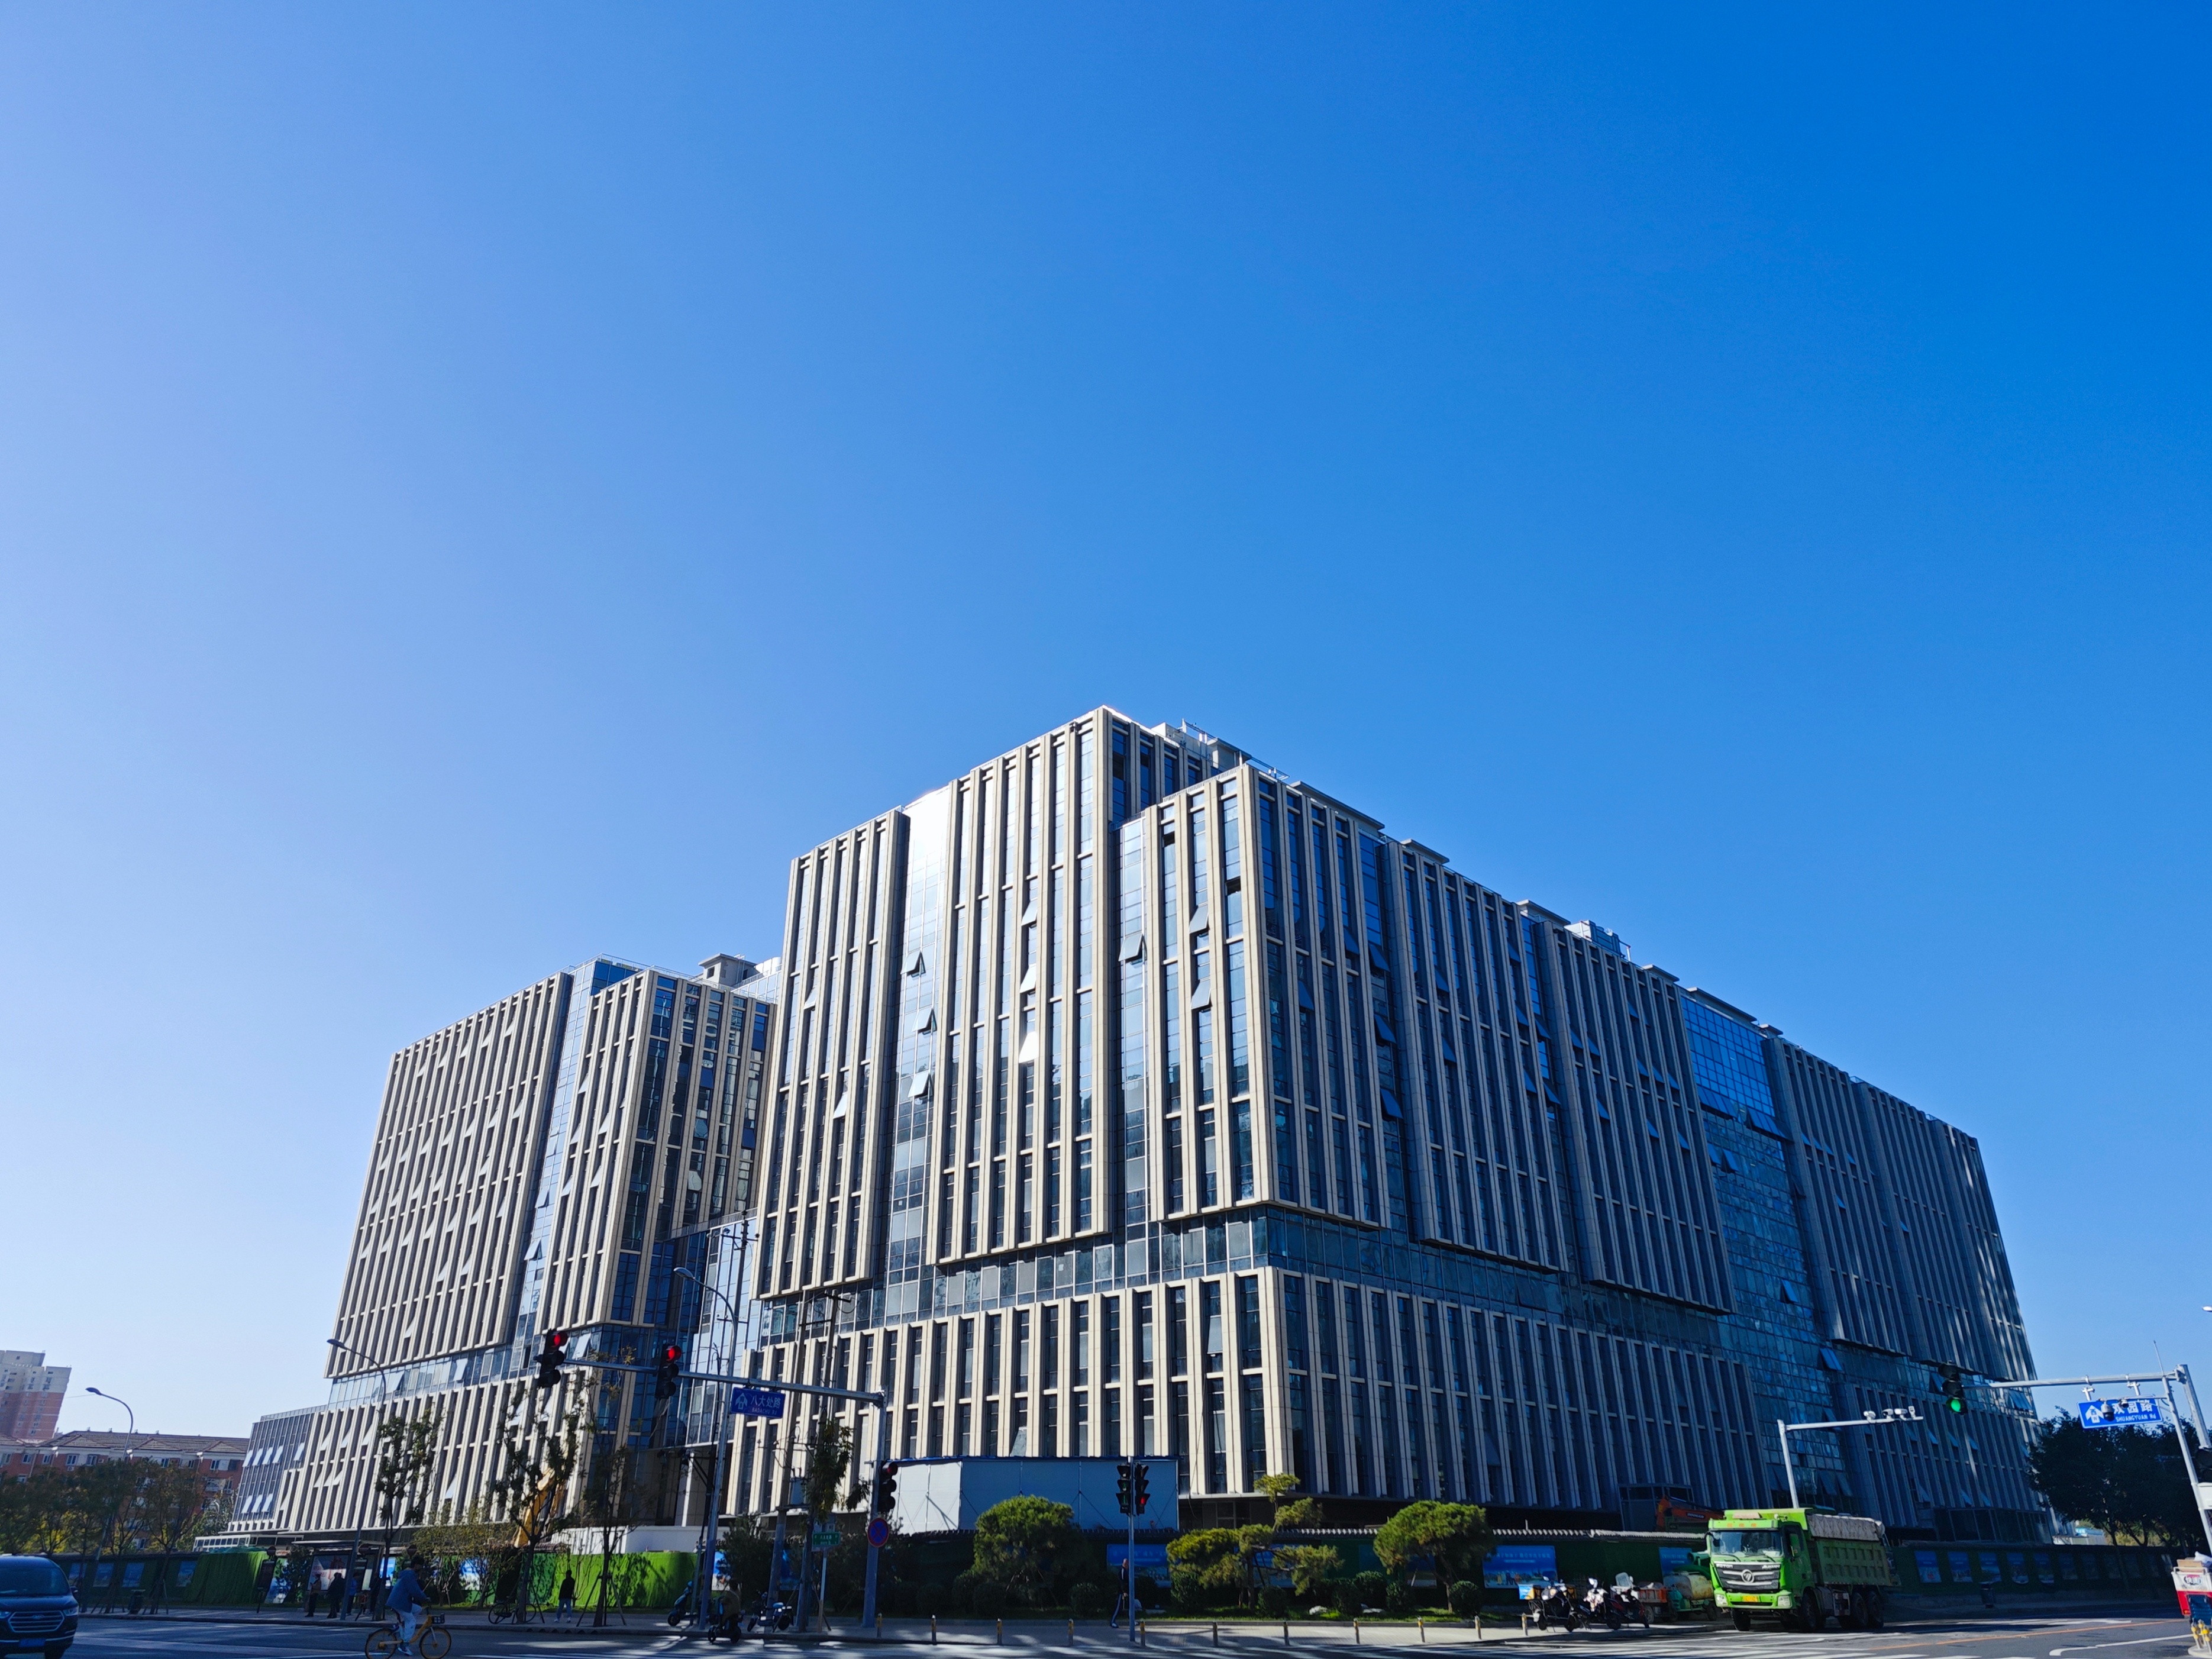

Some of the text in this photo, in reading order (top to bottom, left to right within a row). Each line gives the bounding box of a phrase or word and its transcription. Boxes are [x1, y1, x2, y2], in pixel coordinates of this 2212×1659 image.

[750, 1395, 781, 1409] 八大处路
[2111, 1399, 2153, 1415] 双园路
[2115, 1414, 2148, 1422] SHUANGYUAN
